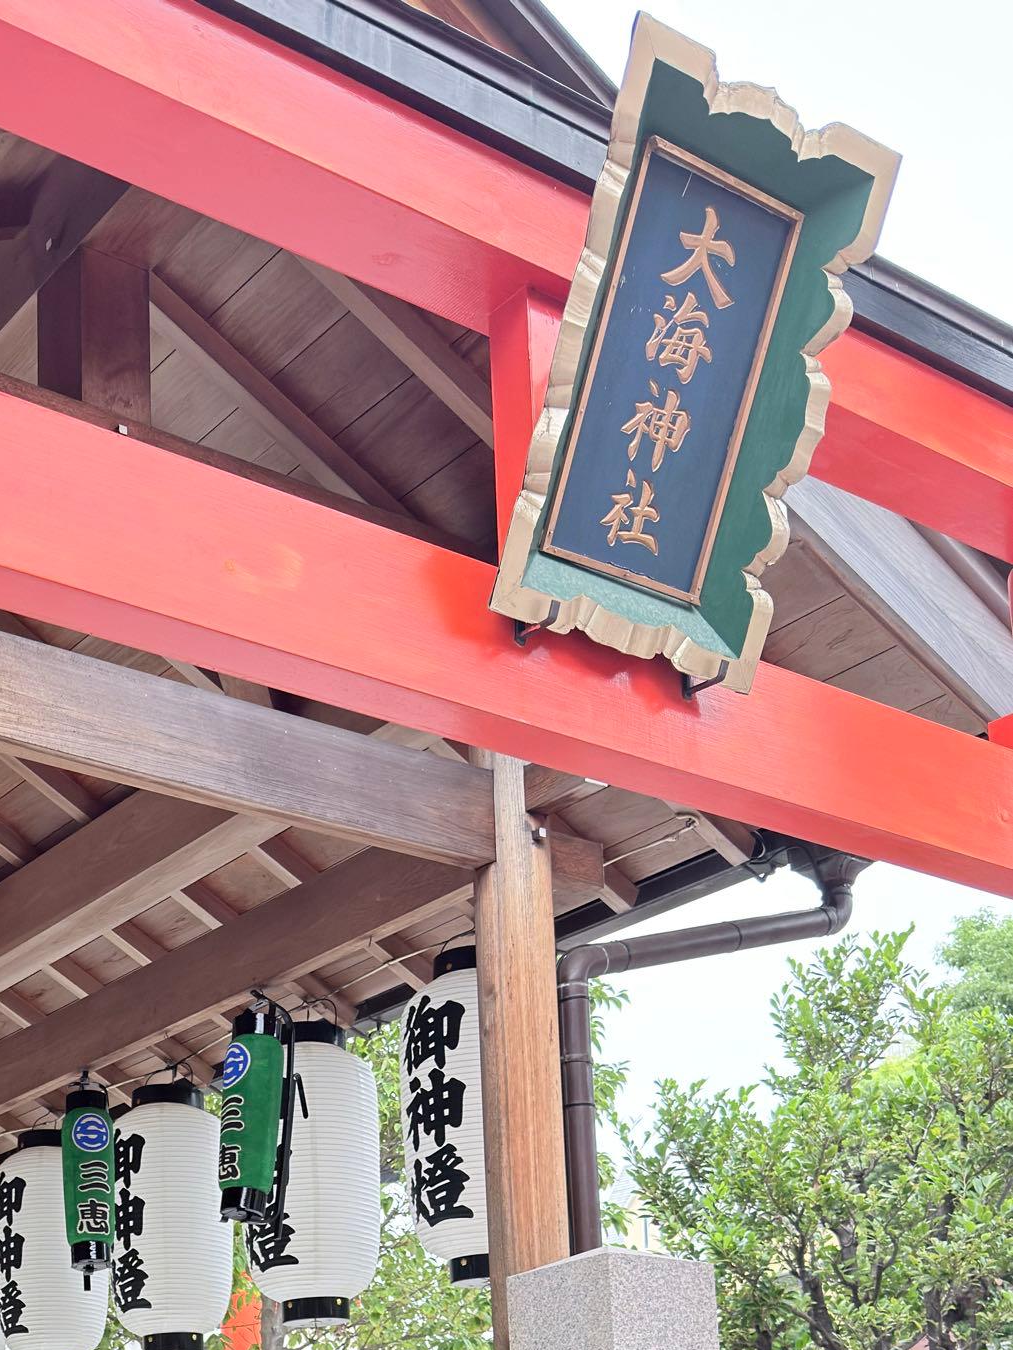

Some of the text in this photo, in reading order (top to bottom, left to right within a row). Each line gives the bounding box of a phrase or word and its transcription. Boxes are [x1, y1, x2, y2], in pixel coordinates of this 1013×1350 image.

[600, 206, 735, 555] 大海神社
[77, 1160, 110, 1235] 三恵
[404, 995, 474, 1227] 御神燈
